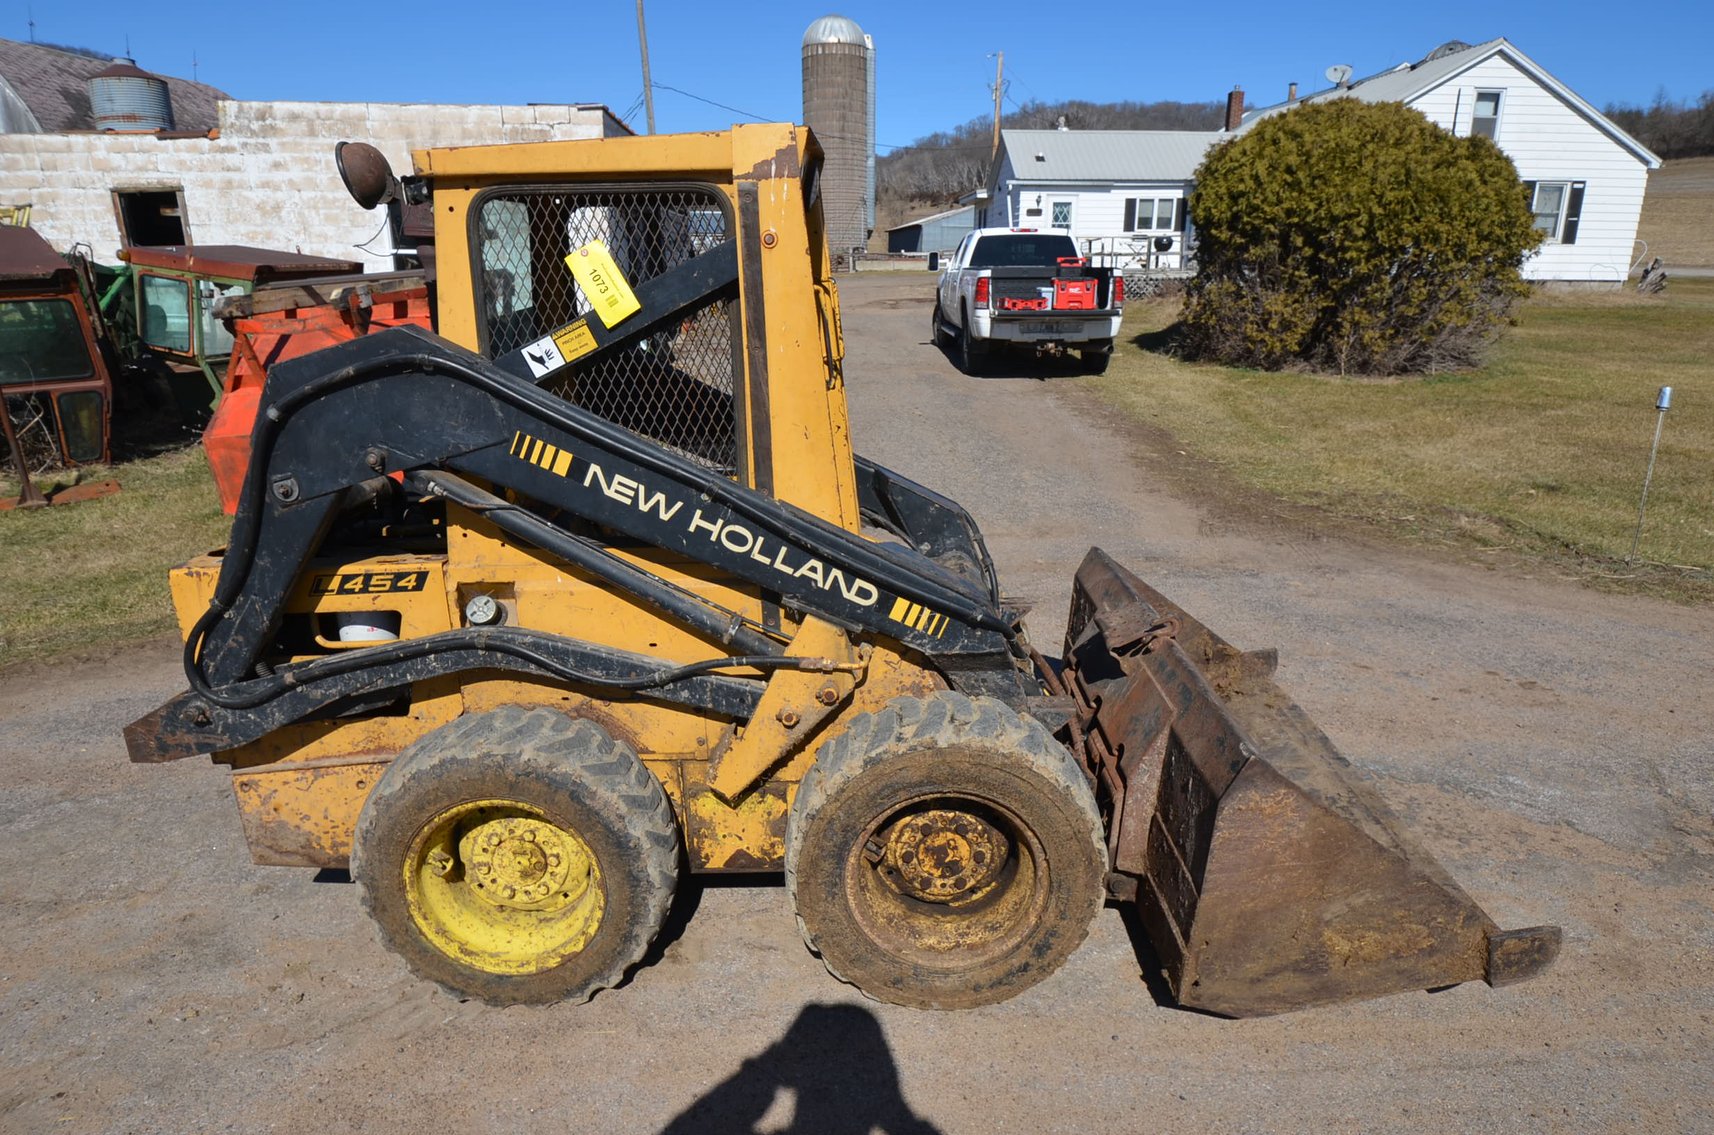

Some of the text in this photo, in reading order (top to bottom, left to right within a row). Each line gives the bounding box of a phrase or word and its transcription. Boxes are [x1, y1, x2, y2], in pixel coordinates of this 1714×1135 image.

[589, 268, 609, 294] 1073
[555, 317, 587, 337] WARNING
[583, 462, 879, 607] NEW HOLLAND
